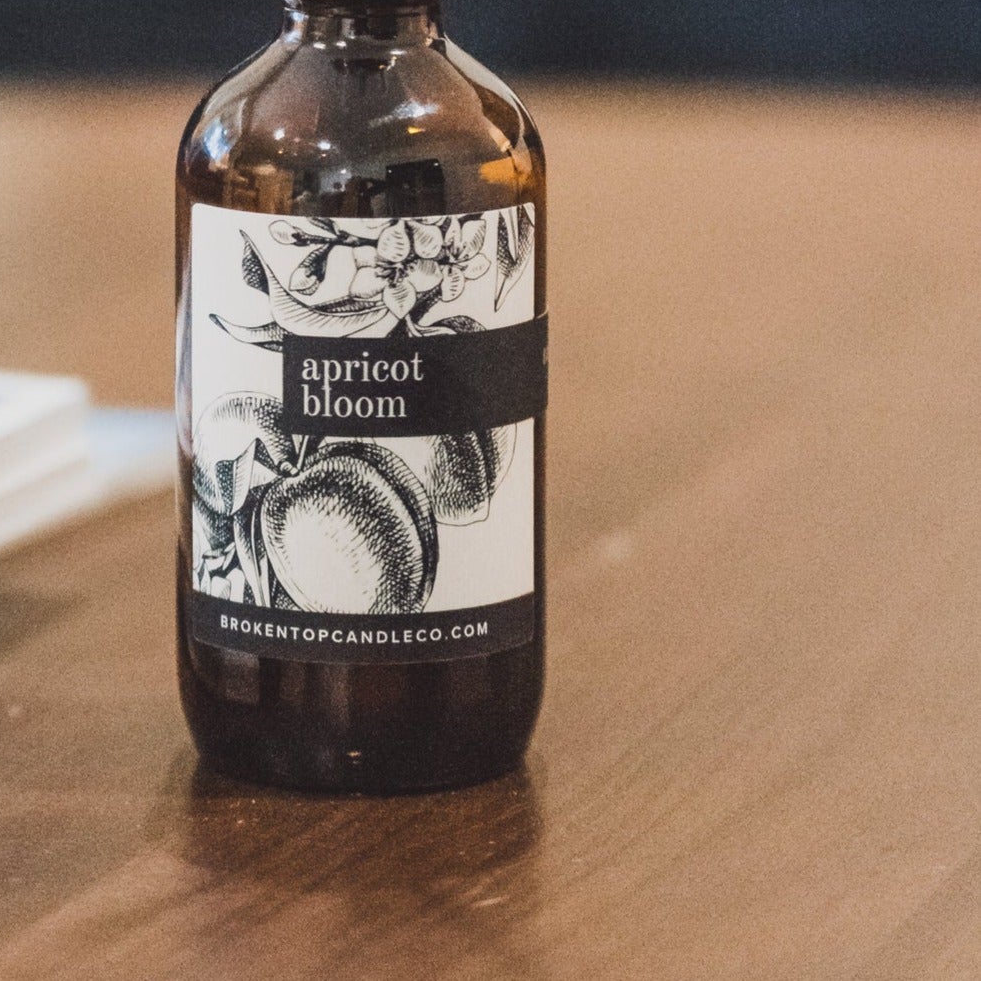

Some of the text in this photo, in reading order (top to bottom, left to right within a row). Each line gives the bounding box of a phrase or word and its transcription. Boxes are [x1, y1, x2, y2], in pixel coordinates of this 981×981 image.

[302, 351, 424, 390] apricot
[302, 385, 407, 417] bloom
[220, 614, 489, 643] BROKENTOPCANDLECO.COM
